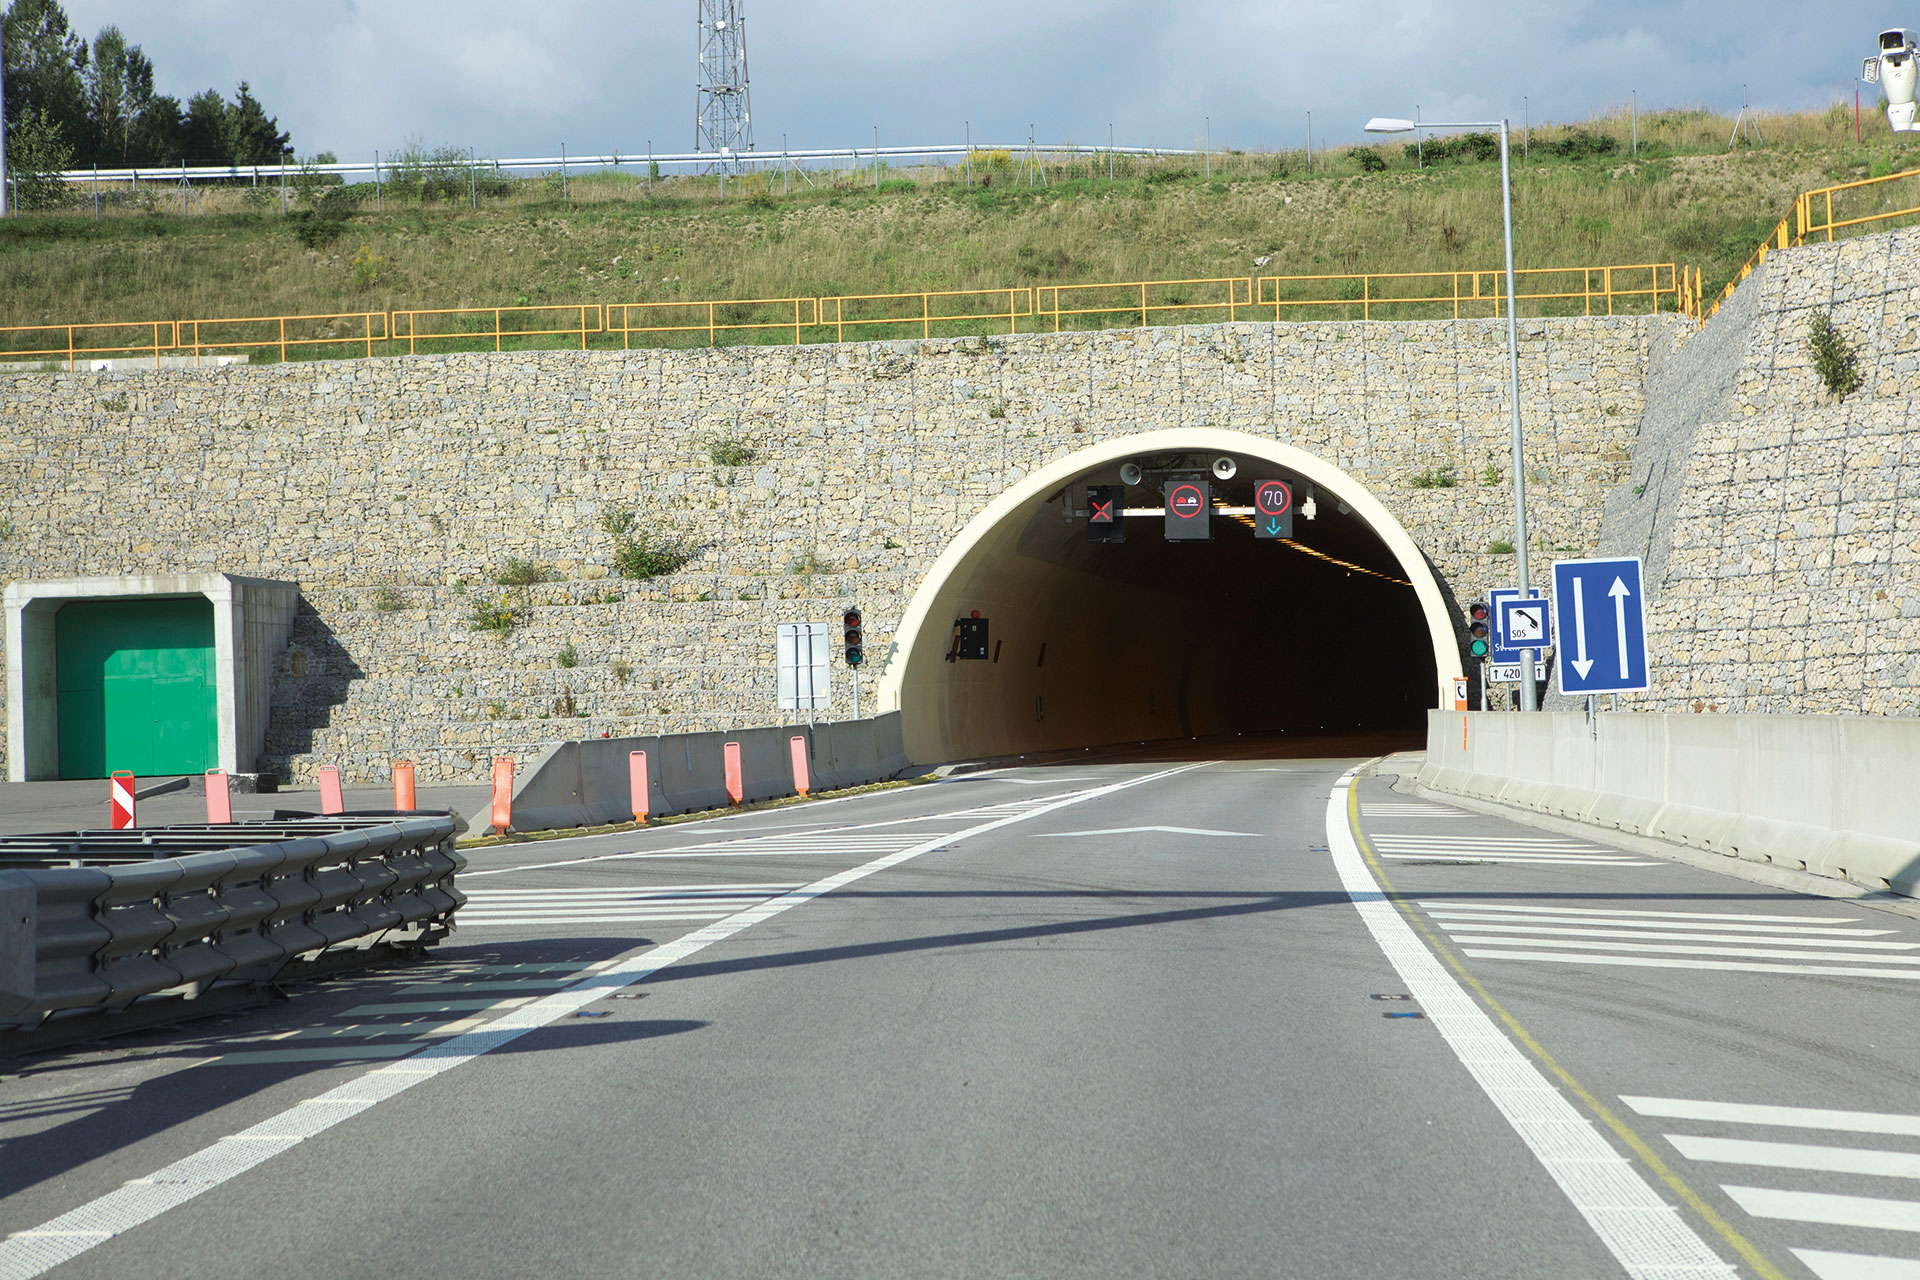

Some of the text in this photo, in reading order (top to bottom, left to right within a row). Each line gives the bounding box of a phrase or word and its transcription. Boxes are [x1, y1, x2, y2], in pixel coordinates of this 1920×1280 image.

[1264, 490, 1283, 506] 70
[1512, 629, 1526, 638] SOS
[1503, 668, 1520, 679] 420
